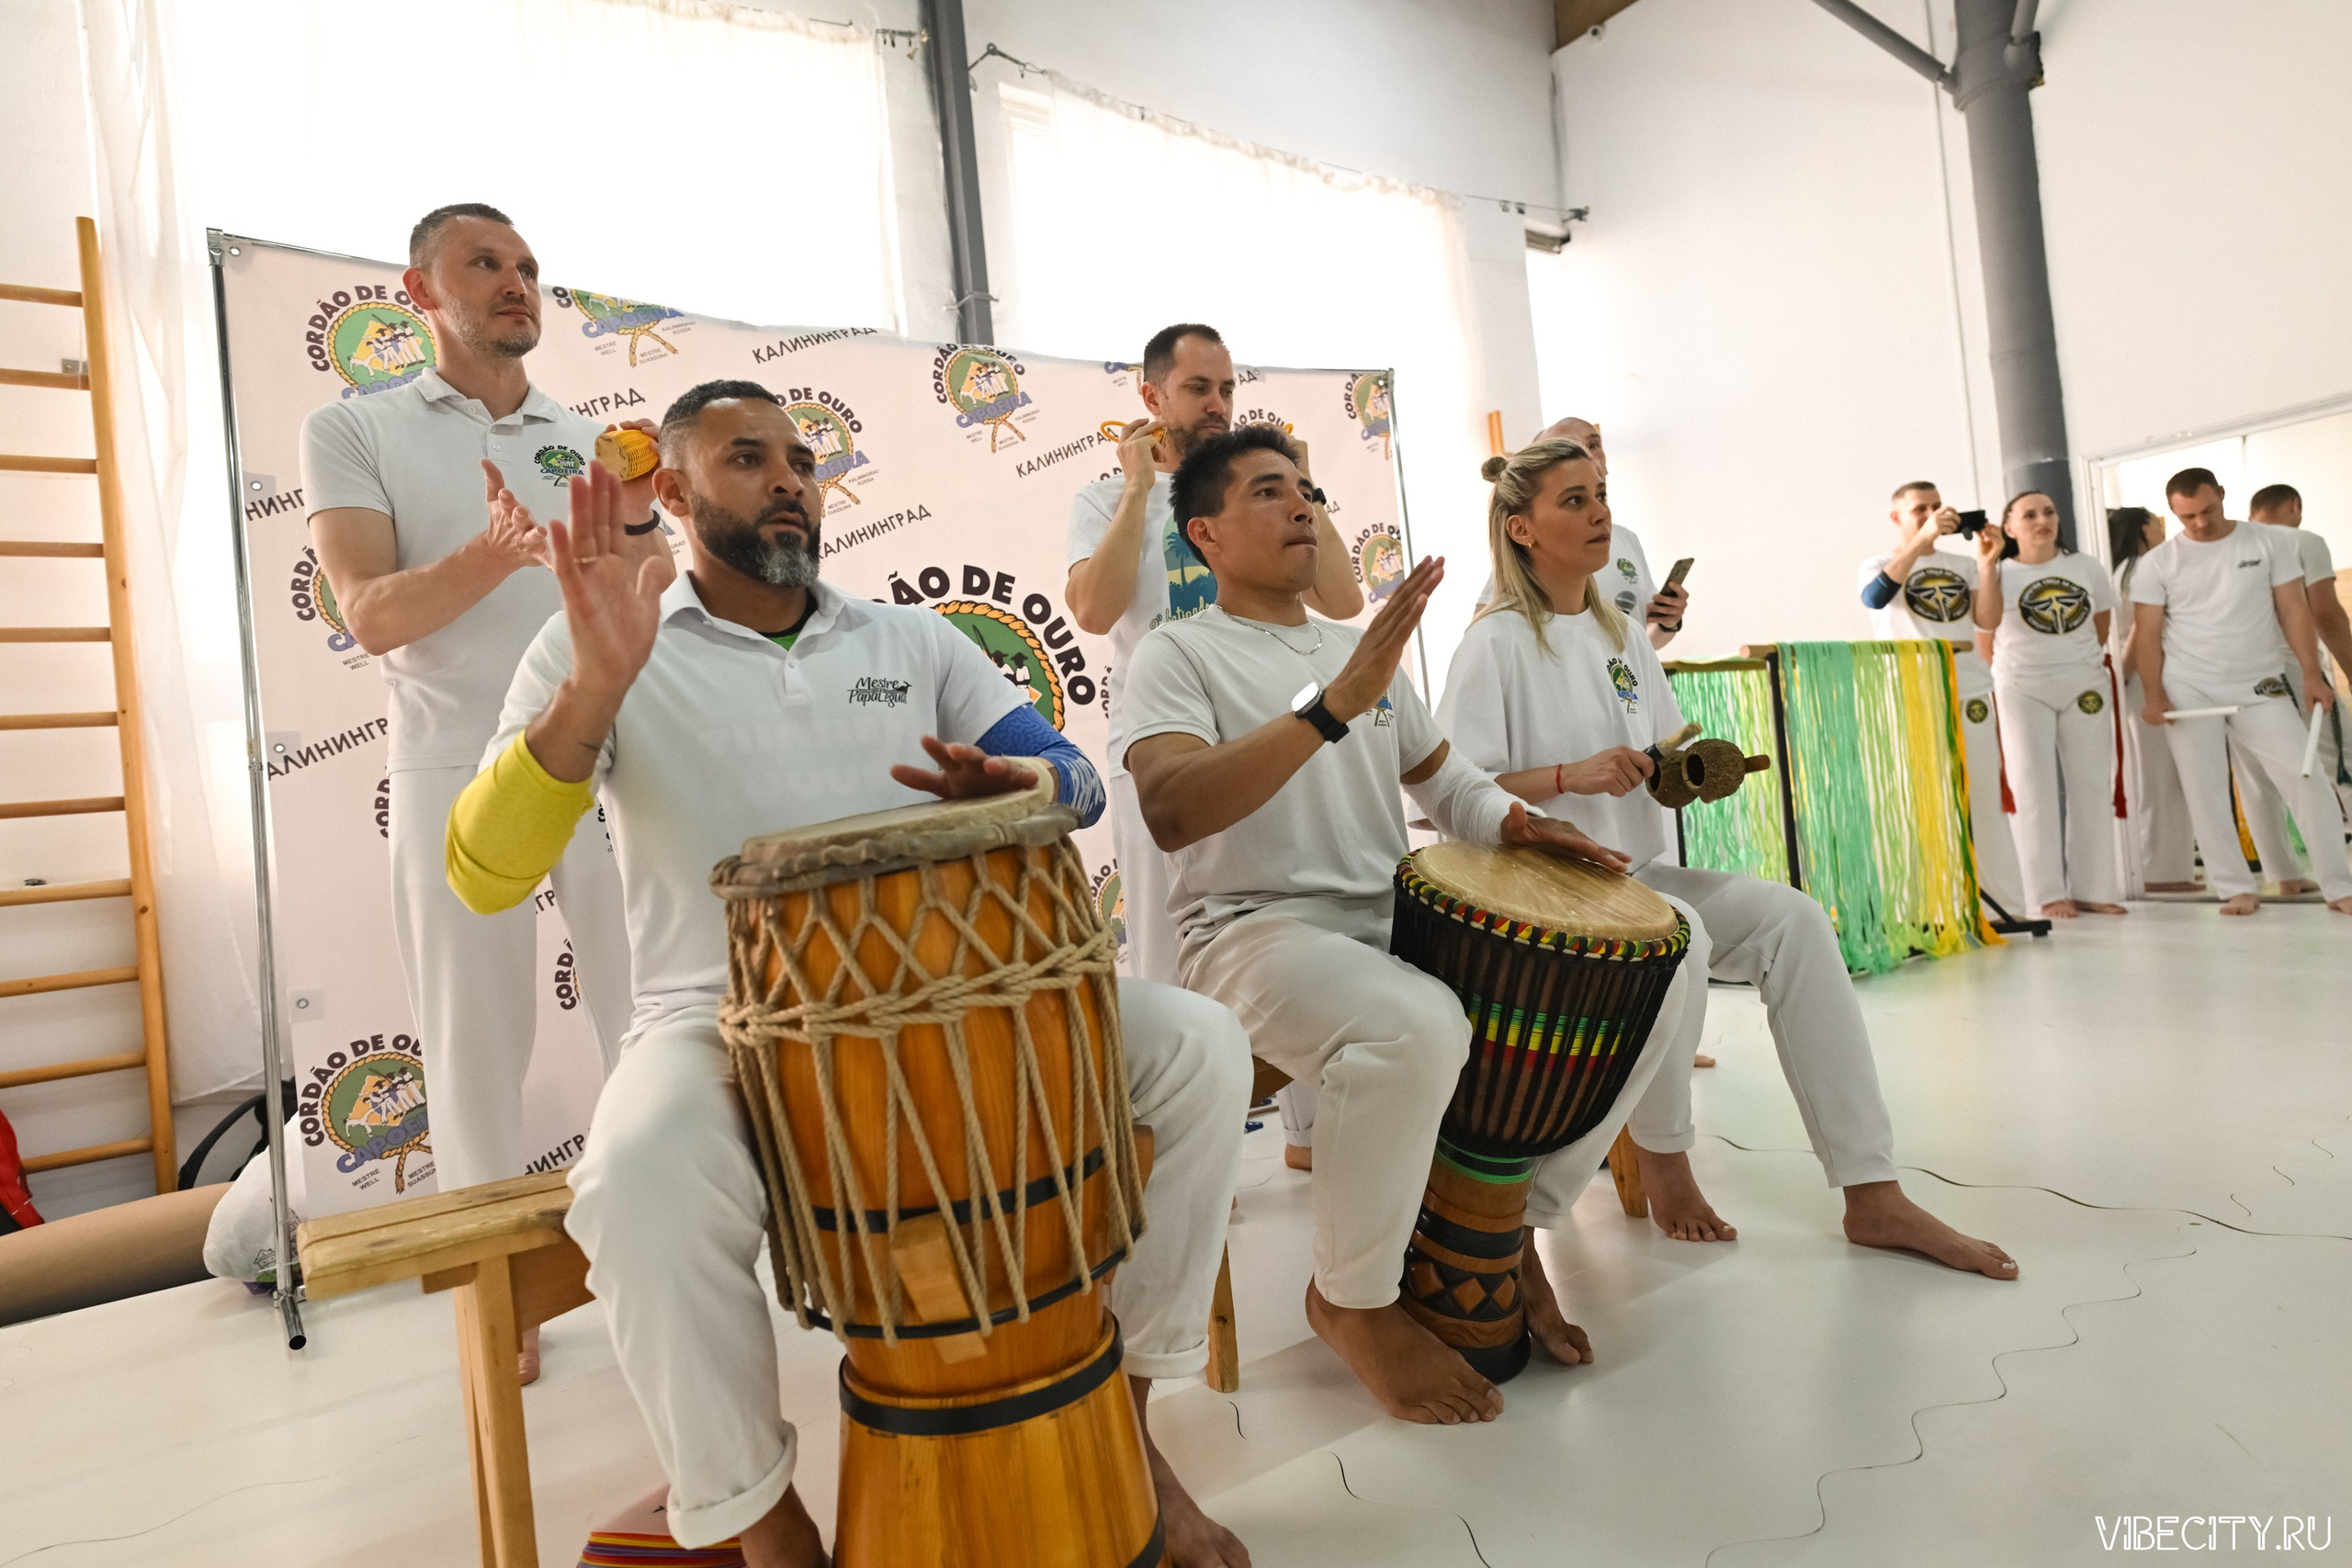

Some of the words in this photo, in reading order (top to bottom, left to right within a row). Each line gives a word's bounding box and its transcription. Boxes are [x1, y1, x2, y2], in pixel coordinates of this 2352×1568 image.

[306, 290, 351, 372] CORDÃO
[355, 285, 388, 300] DE
[570, 388, 646, 418] НГРАД
[788, 388, 813, 401] DE
[818, 391, 863, 434] OURO
[870, 566, 951, 606] ÃO
[962, 564, 1016, 605] DE
[1022, 592, 1096, 706] OURO
[349, 660, 369, 671] WELL
[855, 677, 899, 691] Mestre
[299, 1051, 348, 1146] CORDÃO
[350, 1033, 386, 1058] DE
[351, 1168, 380, 1188] MESTRE
[359, 1177, 380, 1190] WELL
